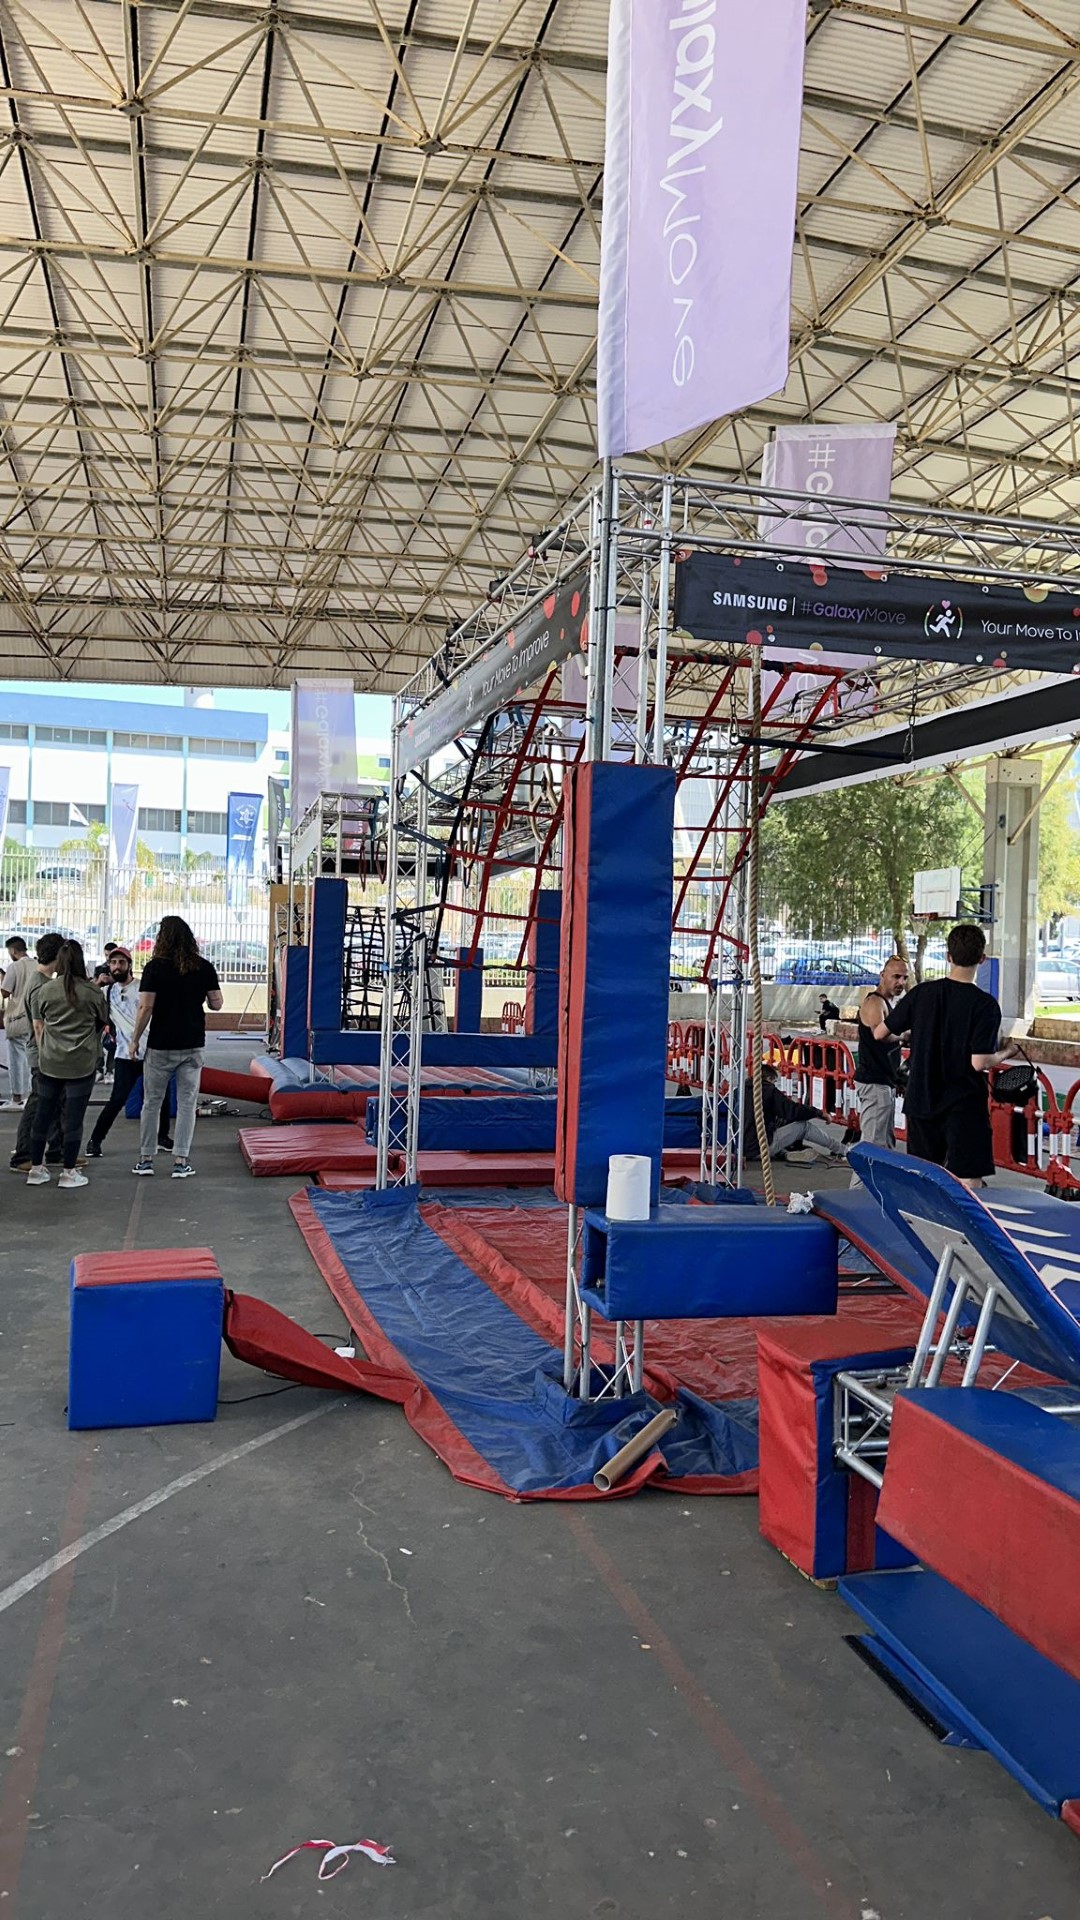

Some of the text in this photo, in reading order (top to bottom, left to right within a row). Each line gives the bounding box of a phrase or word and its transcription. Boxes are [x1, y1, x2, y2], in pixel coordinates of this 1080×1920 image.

[713, 591, 907, 625] SAMSUNG #GalaxyMove
[981, 619, 1013, 635] Your
[1015, 623, 1054, 639] Move
[1056, 627, 1073, 640] To
[494, 662, 511, 688] Move
[511, 654, 519, 674] To
[518, 630, 550, 669] Improve
